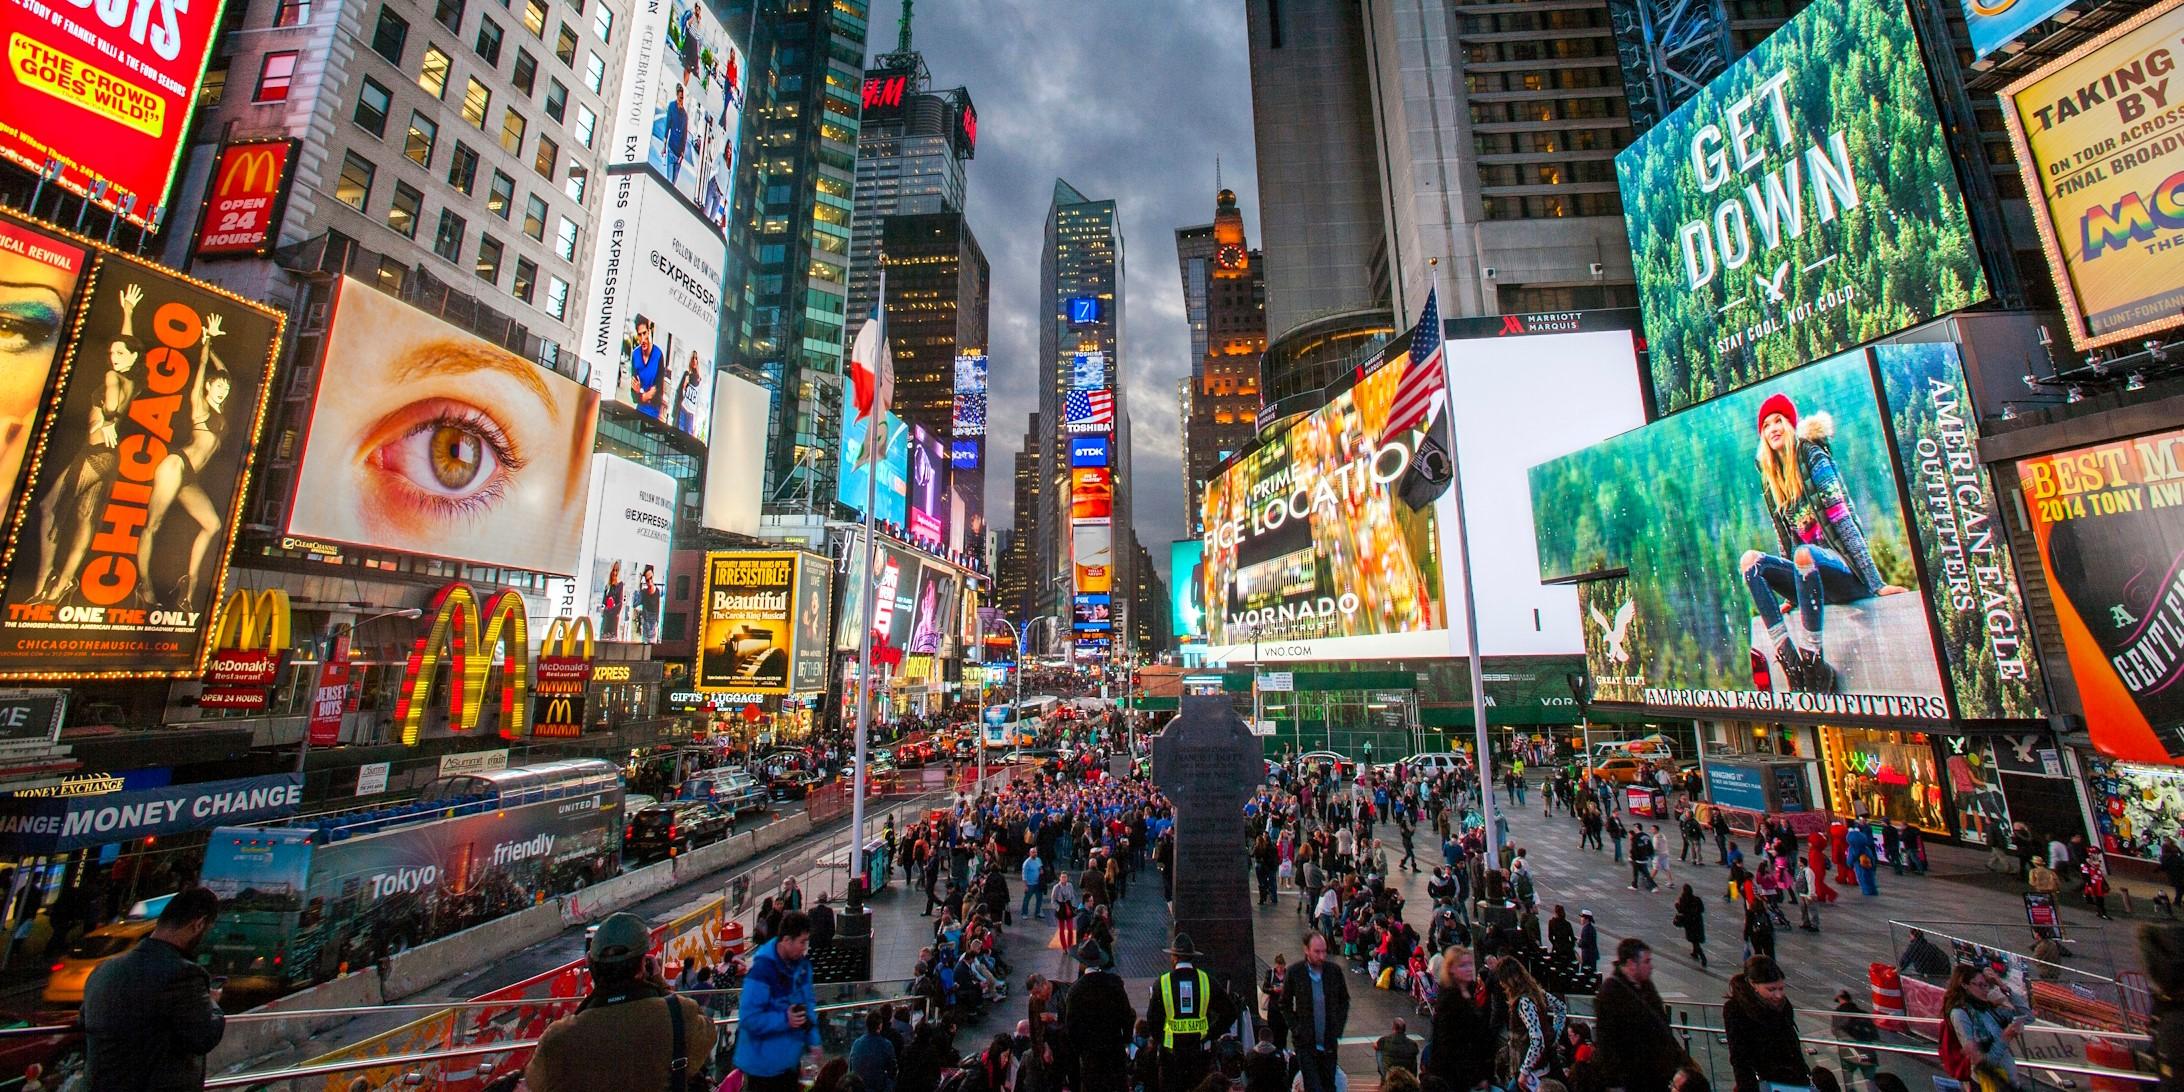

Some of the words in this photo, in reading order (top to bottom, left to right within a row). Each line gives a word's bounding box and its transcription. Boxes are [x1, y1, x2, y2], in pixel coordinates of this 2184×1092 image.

[22, 0, 50, 21] STORY
[51, 12, 64, 27] OF
[63, 18, 97, 48] FRANKIE
[97, 37, 119, 59] VALLI
[117, 50, 126, 65] &
[125, 54, 140, 72] THE
[139, 62, 158, 82] FOUR
[157, 72, 188, 98] SEASONS
[20, 58, 87, 97] GOES
[631, 24, 655, 128] #CELEBRATEYOU
[81, 69, 158, 111] CROWD
[2033, 48, 2176, 132] TAKING
[2115, 77, 2170, 124] BY
[1690, 67, 1794, 194] GET
[2050, 159, 2069, 177] ON
[2073, 136, 2117, 166] TOUR
[2120, 104, 2184, 146] ACROSS
[2055, 167, 2108, 200] FINAL
[218, 197, 267, 211] OPEN
[1679, 130, 1861, 292] DOWN
[218, 211, 258, 231] 24
[204, 231, 263, 247] HOURS
[2144, 232, 2184, 256] THE
[27, 245, 73, 272] REVIVAL
[596, 219, 625, 356] @EXPRESSRUNWAY
[1528, 312, 1583, 323] MARRIOTT
[1528, 321, 1579, 332] MARQUIS
[1717, 333, 1743, 354] STAY
[1746, 317, 1782, 343] COOL.
[1787, 303, 1814, 325] NOT
[1817, 284, 1861, 313] COLD.
[1364, 349, 1386, 369] MARRIOTT
[1364, 358, 1384, 376] MARQUIS
[1258, 403, 1278, 418] MARRIOTT
[1259, 412, 1276, 426] MARQUIS
[1066, 423, 1111, 433] TOSHIBA
[81, 302, 203, 606] CHICAGO
[1082, 448, 1104, 456] TDK
[1253, 461, 1301, 502] PRIME
[2027, 446, 2129, 501] BEST
[1254, 442, 1410, 537] LOCATIO
[2037, 496, 2087, 524] 2014
[2088, 486, 2144, 517] TONY
[1917, 438, 1976, 612] OUTFITTERS
[1928, 377, 1996, 553] AMERICAN
[1975, 563, 2028, 681] EAGLE
[713, 591, 788, 610] Beautiful
[1231, 592, 1360, 630] VORNADO
[4, 621, 18, 629] THE
[8, 603, 56, 621] THE
[58, 606, 105, 623] ONE
[107, 607, 146, 624] THE
[149, 610, 201, 627] ONLY
[713, 611, 725, 620] The
[725, 612, 745, 620] Carole
[746, 611, 761, 621] King
[762, 611, 786, 620] Musical
[2109, 603, 2138, 629] A
[1291, 621, 1336, 632] TRUST
[17, 639, 180, 651] CHICAGOTHEMUSICAL.COM
[1264, 645, 1312, 657] VNO.COM
[207, 656, 275, 673] McDonald's
[538, 663, 590, 672] McDonald's
[593, 666, 630, 680] XPRESS
[214, 673, 262, 681] Restaurant
[202, 693, 223, 702] OPEN
[224, 694, 235, 702] 24
[237, 694, 263, 703] HOURS
[316, 684, 348, 702] JERSEY
[670, 692, 703, 702] GIFTS
[711, 692, 764, 703] LUGGAGE
[319, 700, 342, 717] BOYS
[1646, 689, 1732, 709] AMERICAN
[1735, 691, 1793, 713] EAGLE
[1797, 692, 1949, 721] OUTFITTERS
[13, 786, 59, 798] MONEY
[59, 780, 124, 795] EXCHANGE
[61, 798, 186, 838] MONEY
[193, 784, 303, 818] CHANGE
[558, 800, 592, 814] UNITED
[493, 833, 556, 866] friendly
[372, 864, 438, 899] Tokyo
[1168, 1019, 1187, 1032] PUBLIC
